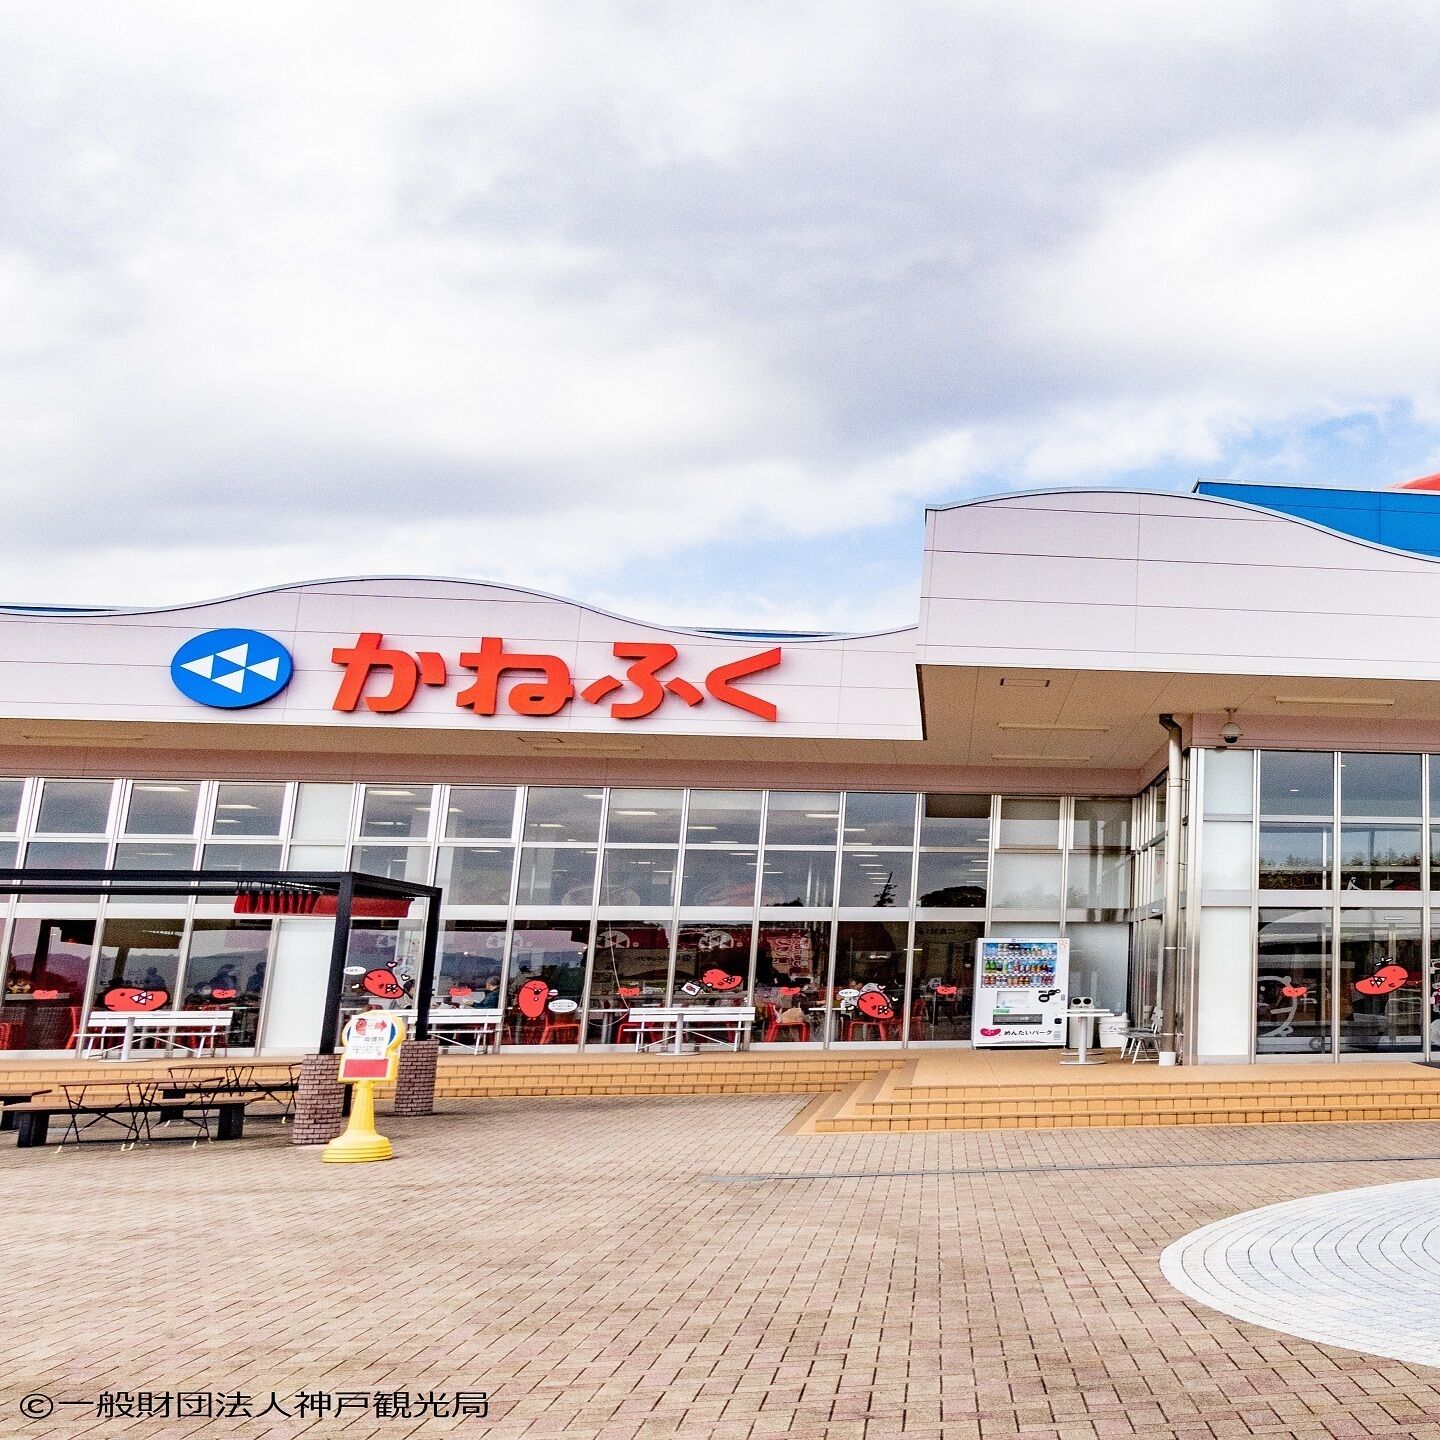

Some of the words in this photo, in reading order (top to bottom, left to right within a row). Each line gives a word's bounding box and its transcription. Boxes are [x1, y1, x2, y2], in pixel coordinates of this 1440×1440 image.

[331, 632, 782, 723] かねふく
[1003, 1028, 1053, 1036] めんたいパーク
